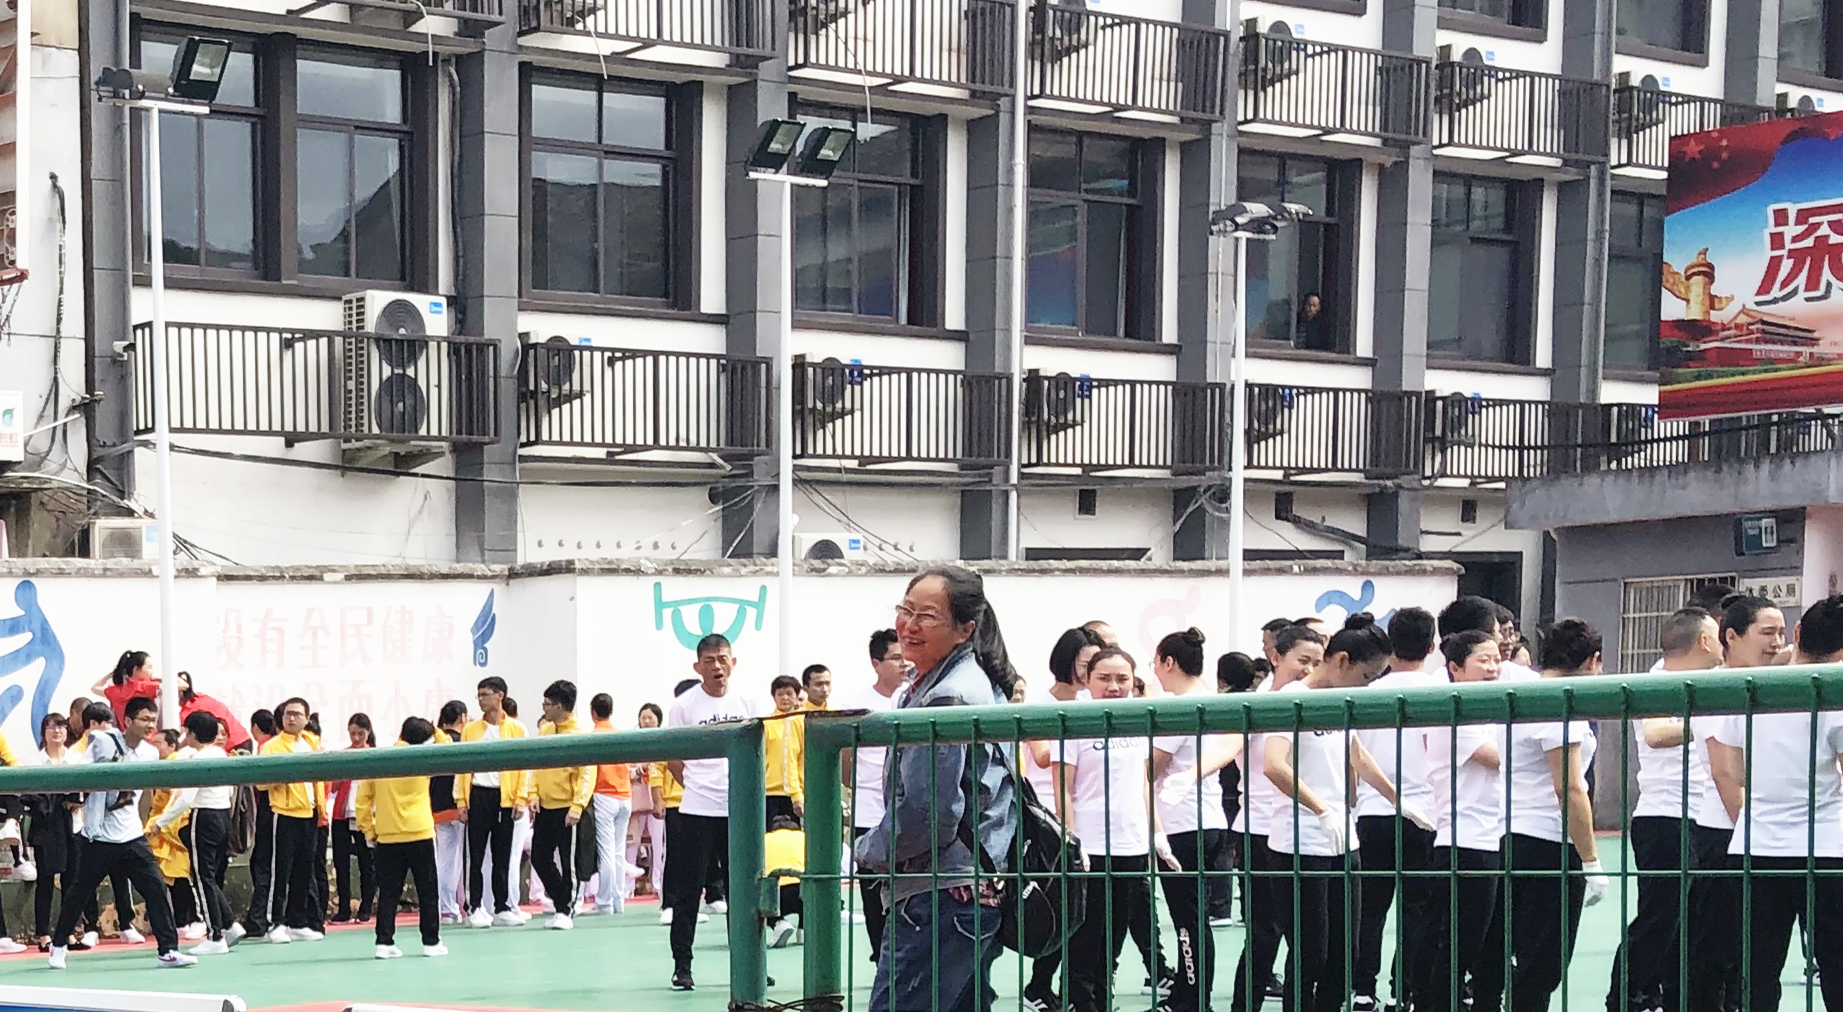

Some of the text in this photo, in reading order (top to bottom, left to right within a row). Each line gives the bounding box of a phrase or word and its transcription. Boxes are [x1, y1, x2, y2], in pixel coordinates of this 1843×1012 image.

[1754, 199, 1843, 302] 深
[0, 432, 18, 443] 长虹
[216, 604, 456, 671] 没有全民健康
